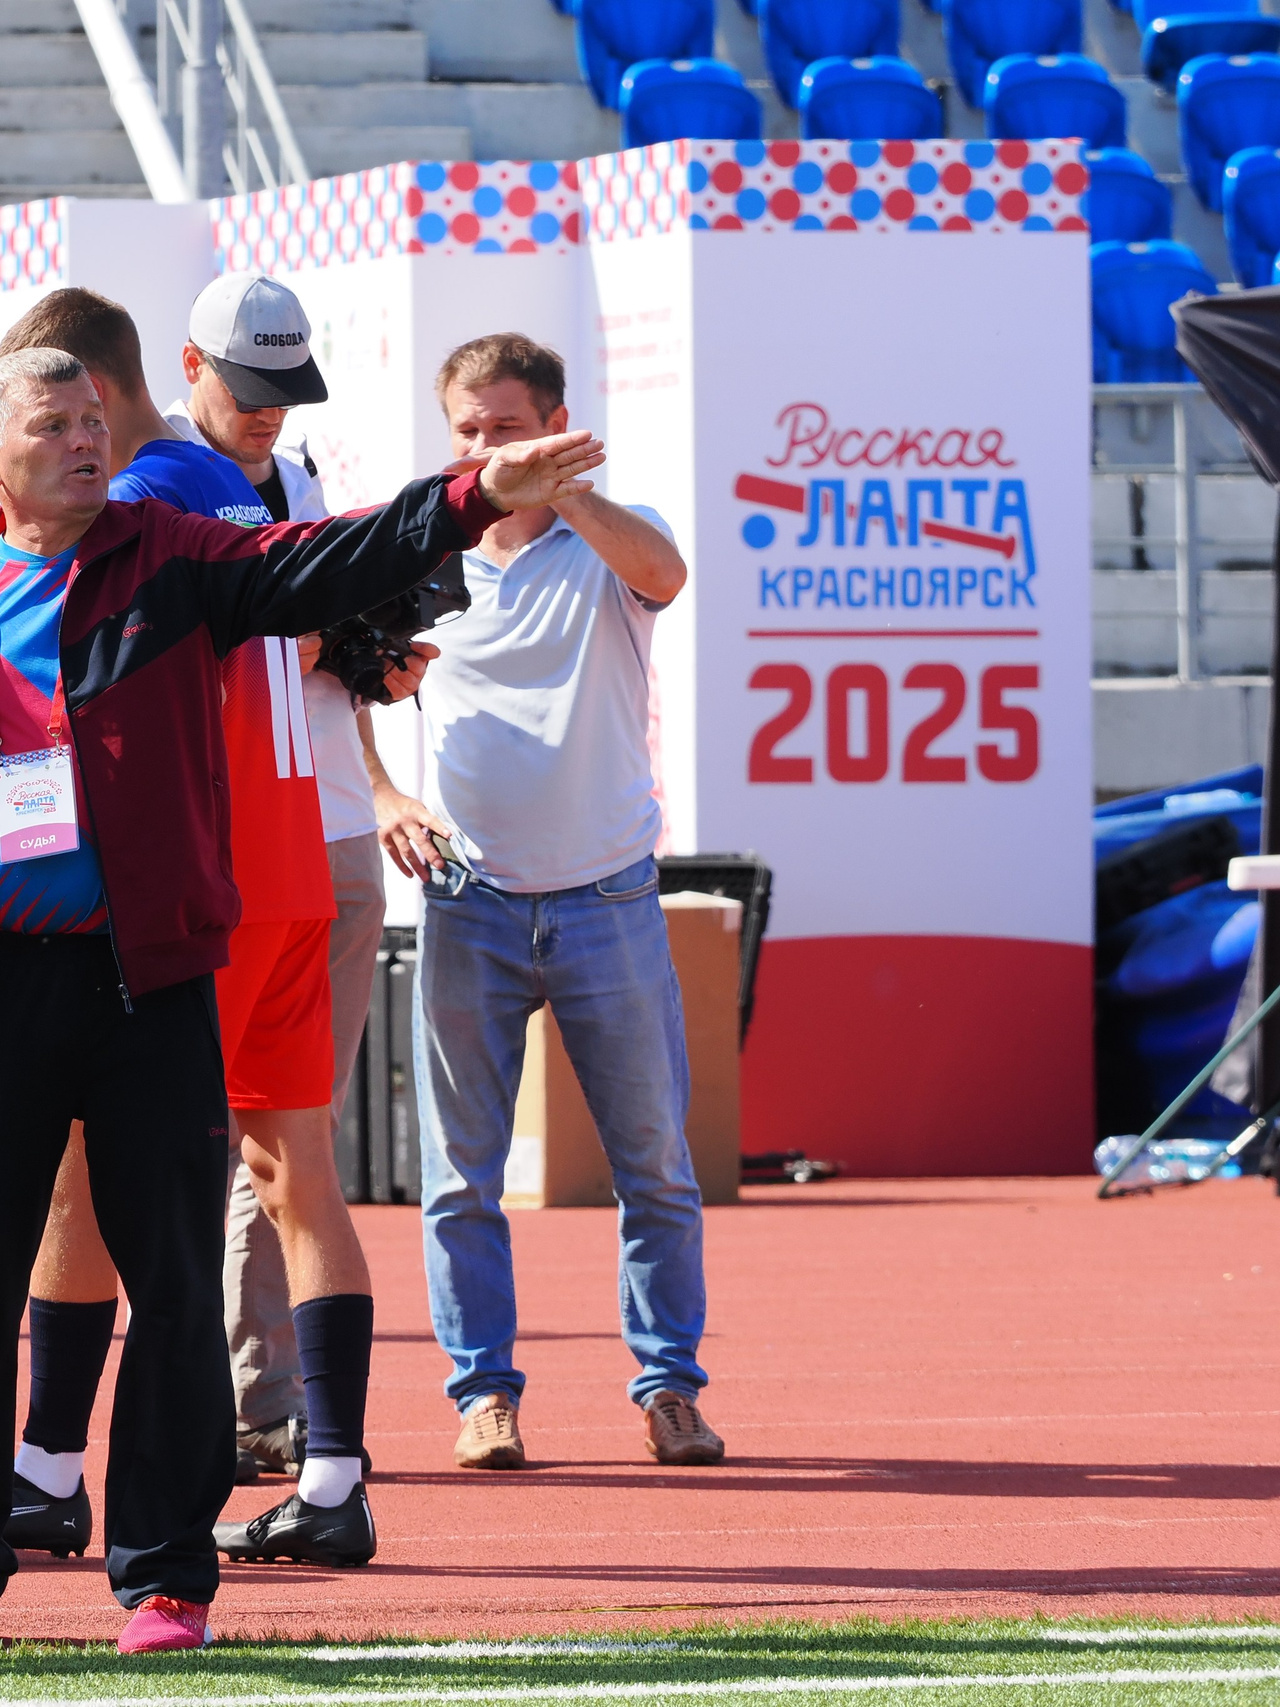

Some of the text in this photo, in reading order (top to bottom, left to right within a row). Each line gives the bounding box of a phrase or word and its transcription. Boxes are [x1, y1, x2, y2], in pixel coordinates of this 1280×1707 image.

[254, 331, 305, 347] СВОБОДА
[765, 401, 1016, 468] Русская
[797, 479, 1036, 574] ЛАПТА
[759, 568, 1036, 608] КРАСНОЯРСК
[748, 662, 1040, 784] 2025
[18, 790, 51, 800] Русская
[23, 796, 55, 809] ЛАПТА
[20, 835, 56, 849] СУДЬЯ
